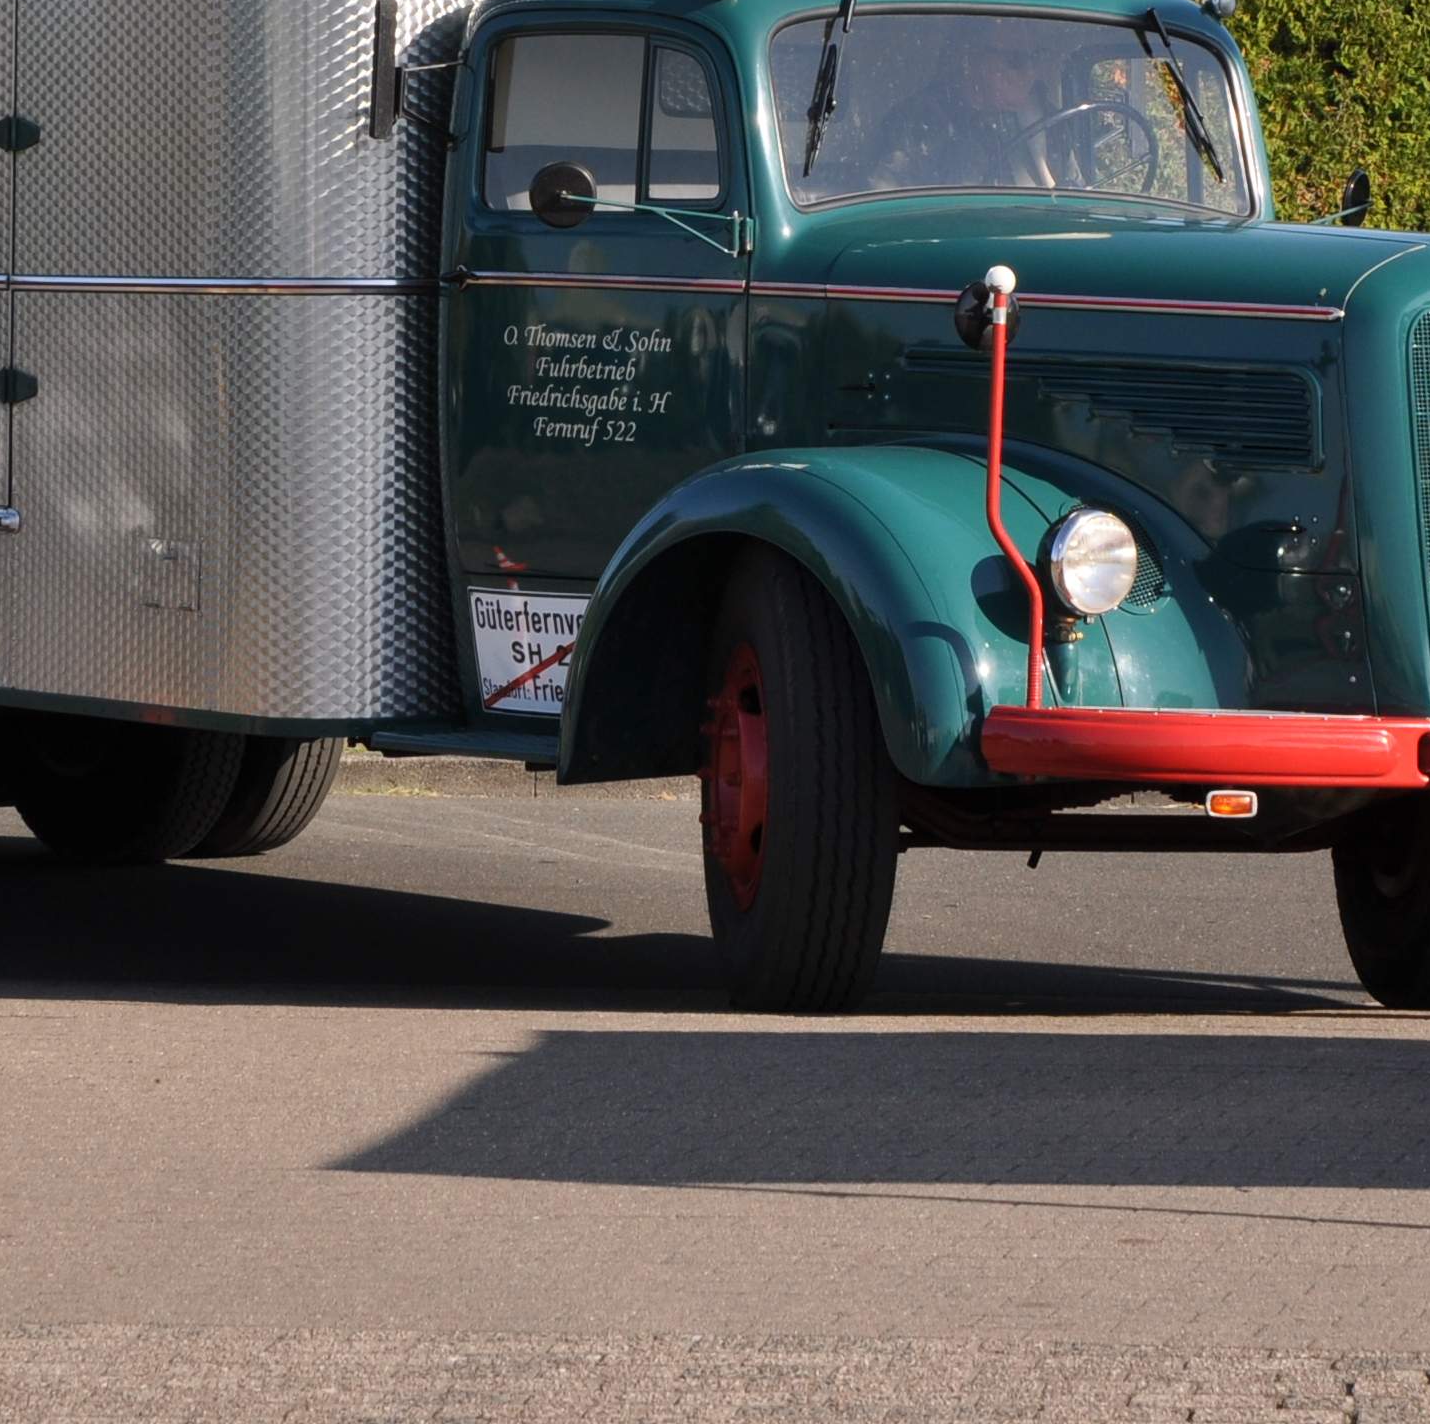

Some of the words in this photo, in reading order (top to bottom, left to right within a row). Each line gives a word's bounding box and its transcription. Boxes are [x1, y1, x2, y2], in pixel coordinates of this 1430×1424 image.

[524, 323, 596, 349] Thomsen
[602, 328, 624, 352] &
[625, 328, 672, 353] Sohn
[536, 354, 636, 382] Fuhrbetrieb
[507, 383, 627, 417] Friedrichsgabe
[633, 391, 642, 412] i.
[533, 416, 603, 447] Fernruf
[603, 420, 637, 442] 522
